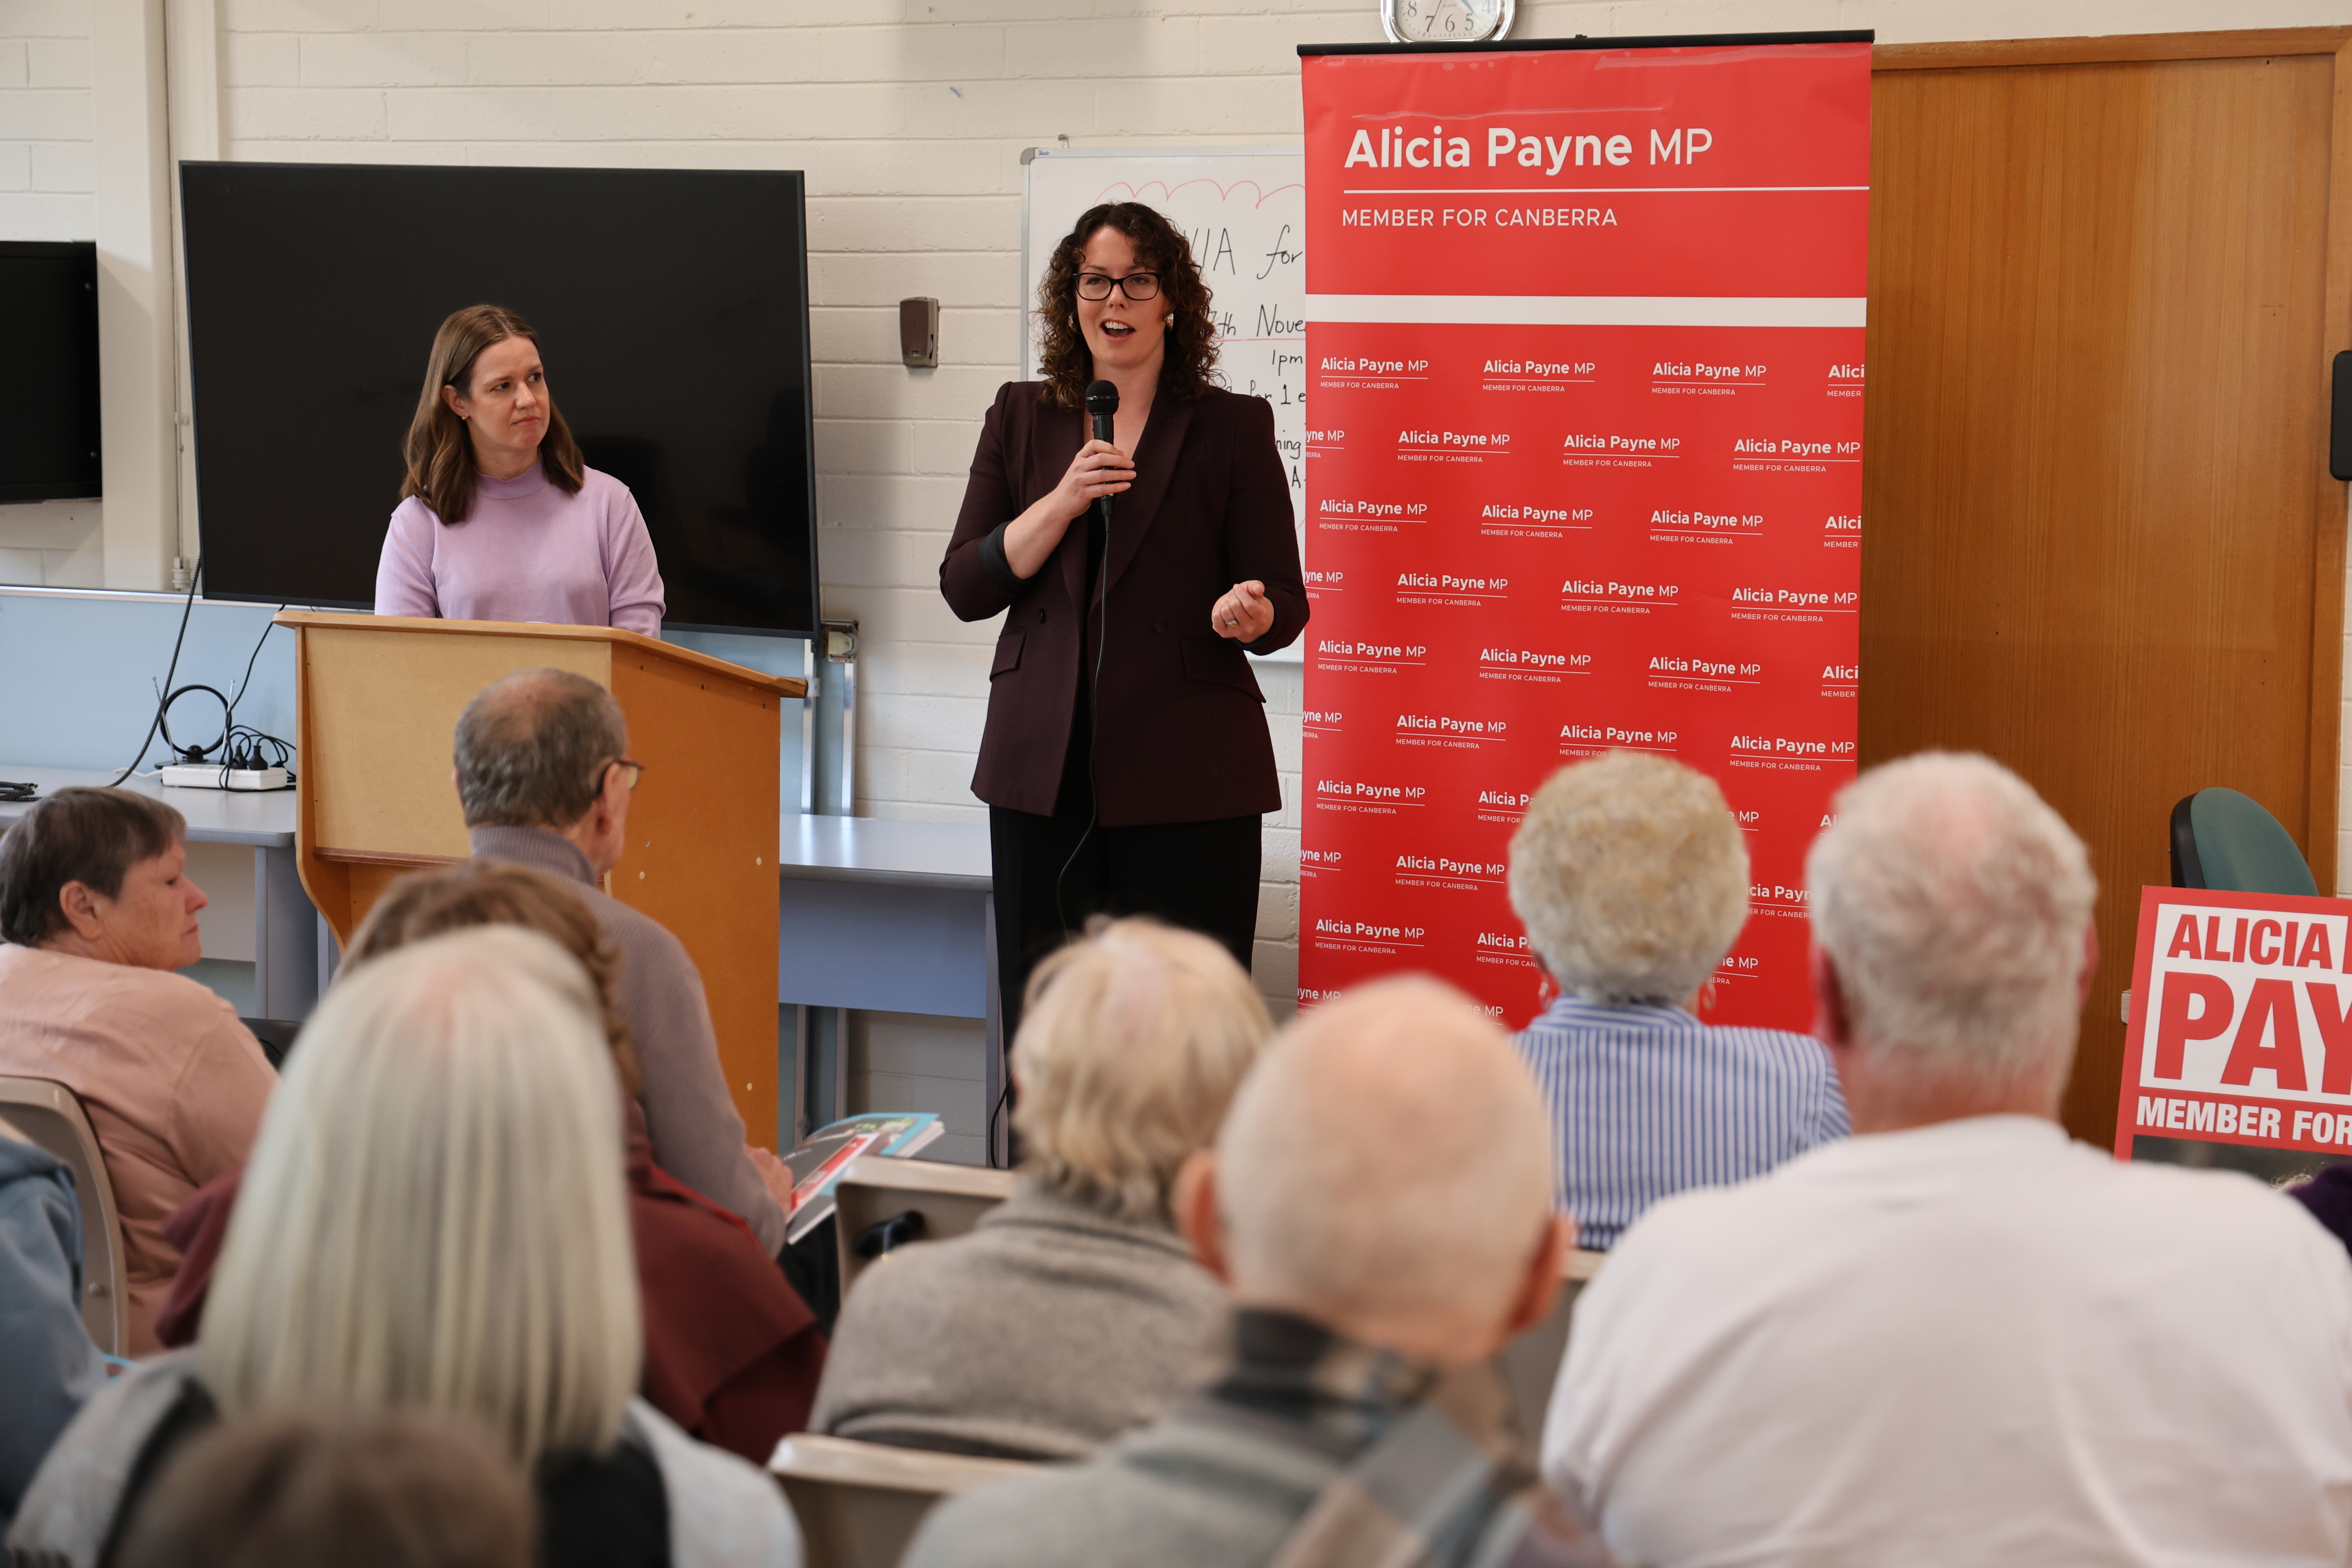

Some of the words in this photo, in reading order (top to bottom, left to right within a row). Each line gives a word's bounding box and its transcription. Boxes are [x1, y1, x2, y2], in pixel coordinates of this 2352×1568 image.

[1408, 0, 1417, 17] 8
[1481, 0, 1492, 14] 4
[1426, 15, 1435, 33] 7
[1445, 14, 1455, 32] 6
[1465, 13, 1474, 31] 5
[1345, 125, 1470, 167] Alicia
[1488, 128, 1632, 176] Payne
[1651, 129, 1712, 164] MP
[1343, 209, 1433, 226] MEMBER
[1444, 209, 1486, 226] FOR
[1495, 209, 1617, 226] CANBERRA
[1183, 228, 1235, 275] VIA
[1257, 225, 1303, 279] for
[1256, 303, 1306, 337] Nove
[1321, 357, 1355, 370] Alicia
[1359, 358, 1403, 374] Payne
[1408, 360, 1428, 371] MP
[1483, 359, 1521, 373] Alicia
[1526, 361, 1570, 376] Payne
[1575, 363, 1595, 374] MP
[1653, 362, 1691, 376] Alicia
[1696, 363, 1740, 379] Payne
[1745, 365, 1766, 377] MP
[1828, 364, 1865, 378] Alici
[1280, 384, 1291, 405] 1
[1276, 429, 1301, 459] ning
[1327, 430, 1345, 441] MP
[1398, 430, 1439, 444] Alicia
[1443, 432, 1487, 447] Payne
[1492, 434, 1510, 445] MP
[1564, 434, 1605, 448] Alicia
[1610, 436, 1656, 452] Payne
[1661, 438, 1680, 450] MP
[1734, 438, 1776, 453] Alicia
[1782, 440, 1832, 456] Payne
[1837, 442, 1860, 454] MP
[1320, 499, 1354, 513] Alicia
[1358, 501, 1402, 517] Payne
[1407, 503, 1427, 515] MP
[1651, 510, 1690, 524] Alicia
[1694, 512, 1738, 528] Payne
[1742, 515, 1763, 527] MP
[1825, 515, 1861, 529] Alici
[1326, 571, 1343, 583] MP
[1397, 573, 1437, 587] Alicia
[1442, 575, 1485, 591] Payne
[1490, 578, 1508, 590] MP
[1732, 588, 1773, 602] Alicia
[1779, 590, 1829, 606] Payne
[1834, 592, 1857, 604] MP
[1318, 640, 1352, 654] Alicia
[1357, 642, 1401, 658] Payne
[1406, 646, 1426, 657] MP
[1649, 657, 1688, 671] Alicia
[1693, 659, 1736, 676] Payne
[1740, 663, 1760, 675] MP
[1822, 665, 1858, 679] Alici
[1325, 711, 1342, 723] MP
[1397, 715, 1436, 729] Alicia
[1441, 717, 1484, 733] Payne
[1488, 721, 1506, 733] MP
[1560, 725, 1601, 739] Alicia
[1607, 727, 1653, 743] Payne
[1658, 731, 1677, 743] MP
[1730, 735, 1771, 750] Alicia
[1776, 738, 1826, 755] Payne
[1832, 741, 1855, 753] MP
[1317, 780, 1352, 794] Alicia
[1356, 783, 1401, 799] Payne
[1406, 787, 1425, 798] MP
[1478, 791, 1515, 805] Alicia
[1739, 810, 1759, 822] MP
[1324, 851, 1341, 863] MP
[1396, 855, 1435, 869] Alicia
[1440, 858, 1482, 875] Payne
[1486, 863, 1505, 875] MP
[1316, 919, 1351, 934] Alicia
[1356, 922, 1400, 938] Payne
[1405, 927, 1424, 938] MP
[1477, 933, 1514, 947] Alicia
[2167, 914, 2333, 970] ALICIA
[1739, 956, 1758, 969] MP
[1485, 1005, 1504, 1017] MP
[2136, 1096, 2281, 1138] MEMBER
[2292, 1110, 2352, 1145] FOR
